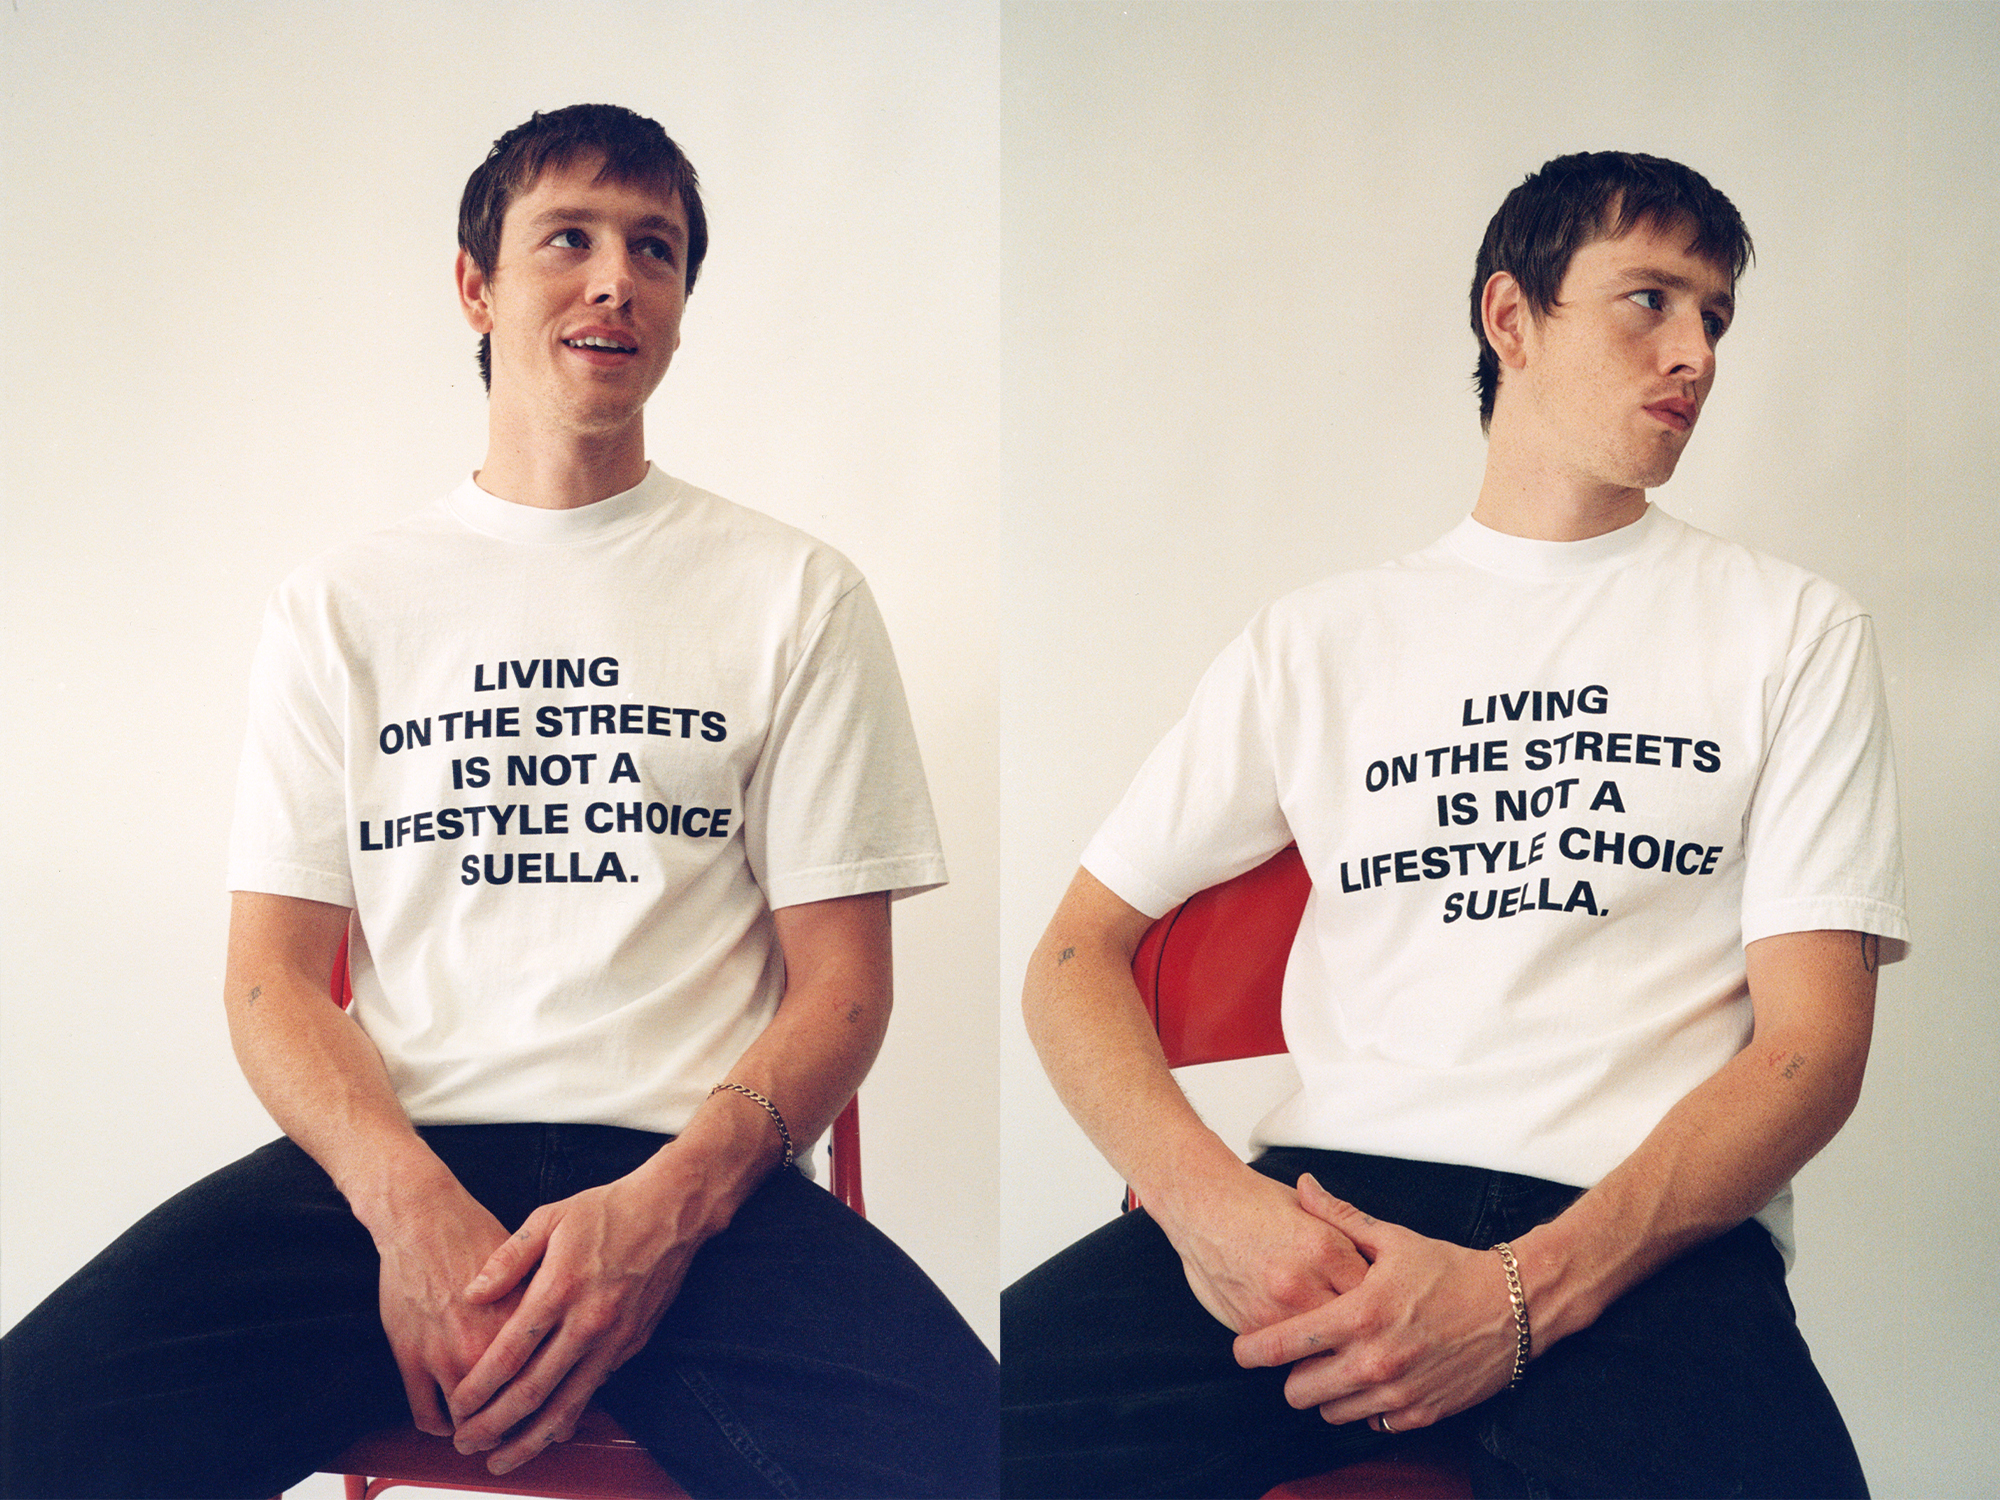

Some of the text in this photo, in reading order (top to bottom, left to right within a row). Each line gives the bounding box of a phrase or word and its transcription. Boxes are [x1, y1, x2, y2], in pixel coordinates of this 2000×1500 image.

[474, 656, 619, 692] LIVING
[379, 704, 727, 755] ON THE STREETS
[1462, 684, 1609, 727] LIVING
[451, 752, 641, 790] IS NOT A
[1365, 731, 1721, 793] ON THE STREETS
[360, 801, 732, 851] LIFESTYLE CHOICE
[1437, 778, 1626, 827] IS NOT A
[461, 851, 639, 886] SUELLA.
[1340, 827, 1724, 894] LIFESTYLE CHOICE
[1443, 877, 1609, 924] SUELLA.
